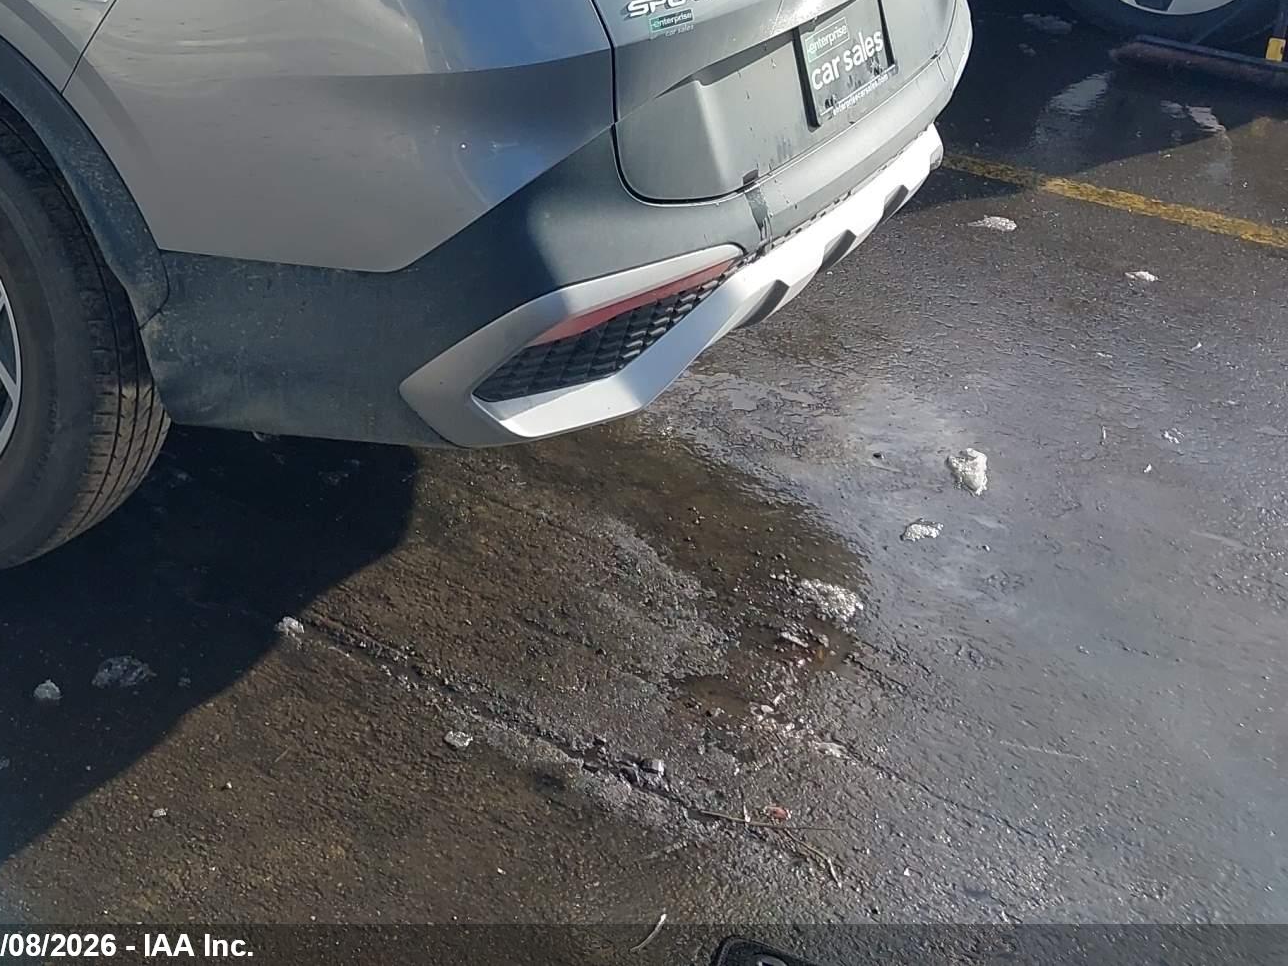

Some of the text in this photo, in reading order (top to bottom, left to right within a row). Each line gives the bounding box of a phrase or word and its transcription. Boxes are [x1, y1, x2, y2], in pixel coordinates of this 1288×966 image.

[808, 24, 848, 54] enterprise
[811, 32, 884, 91] car sales
